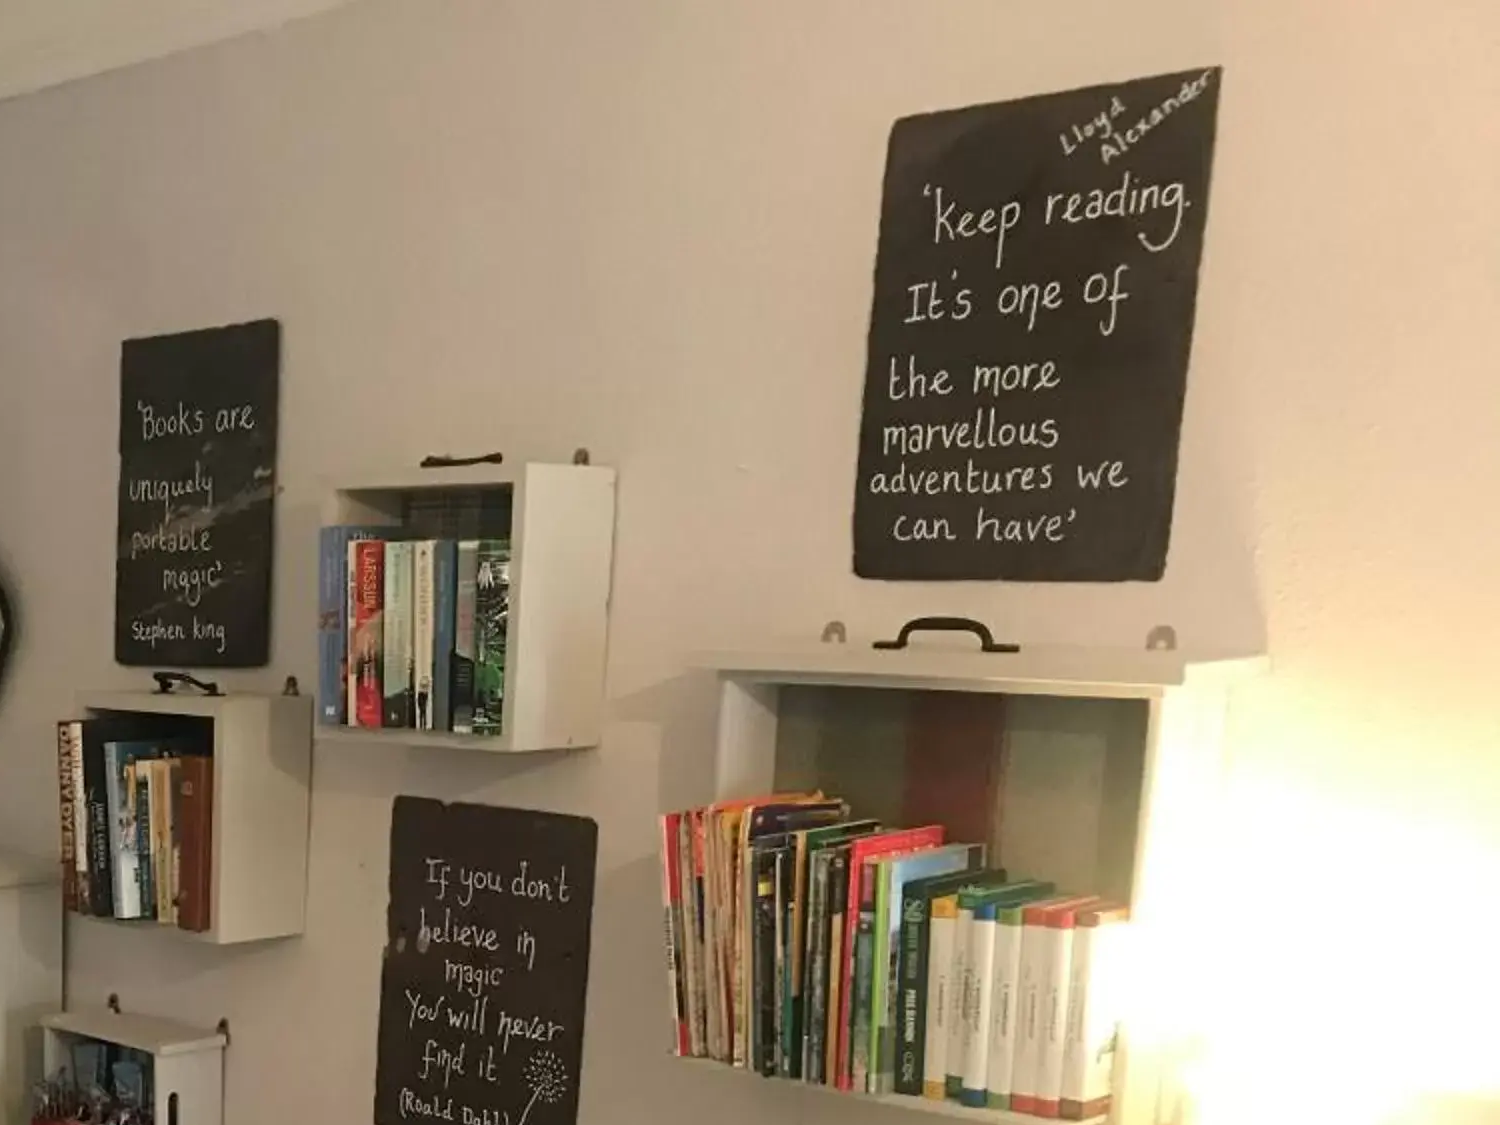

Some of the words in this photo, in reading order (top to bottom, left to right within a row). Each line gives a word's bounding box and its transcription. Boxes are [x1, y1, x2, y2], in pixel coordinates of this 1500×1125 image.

[1059, 96, 1127, 157] Lloyd
[1099, 68, 1213, 166] Alexander
[904, 268, 972, 324] It's
[998, 279, 1064, 333] one
[1083, 264, 1130, 337] of
[889, 355, 953, 401] the
[972, 360, 1062, 398] more
[215, 404, 256, 433] are
[882, 406, 1060, 456] marvellous
[869, 459, 1053, 495] adventures
[1076, 460, 1130, 492] we
[131, 529, 212, 560] portable
[892, 514, 957, 542] can
[132, 619, 185, 648] Stephen
[425, 857, 452, 900] If
[457, 866, 503, 907] you
[511, 861, 570, 902] don't
[419, 907, 500, 950] believe
[516, 926, 536, 971] in
[445, 958, 504, 997] magic
[404, 989, 445, 1029] You
[447, 998, 489, 1035] will
[497, 1009, 565, 1055] never
[419, 1039, 465, 1088] find
[399, 1087, 455, 1122] (Roald
